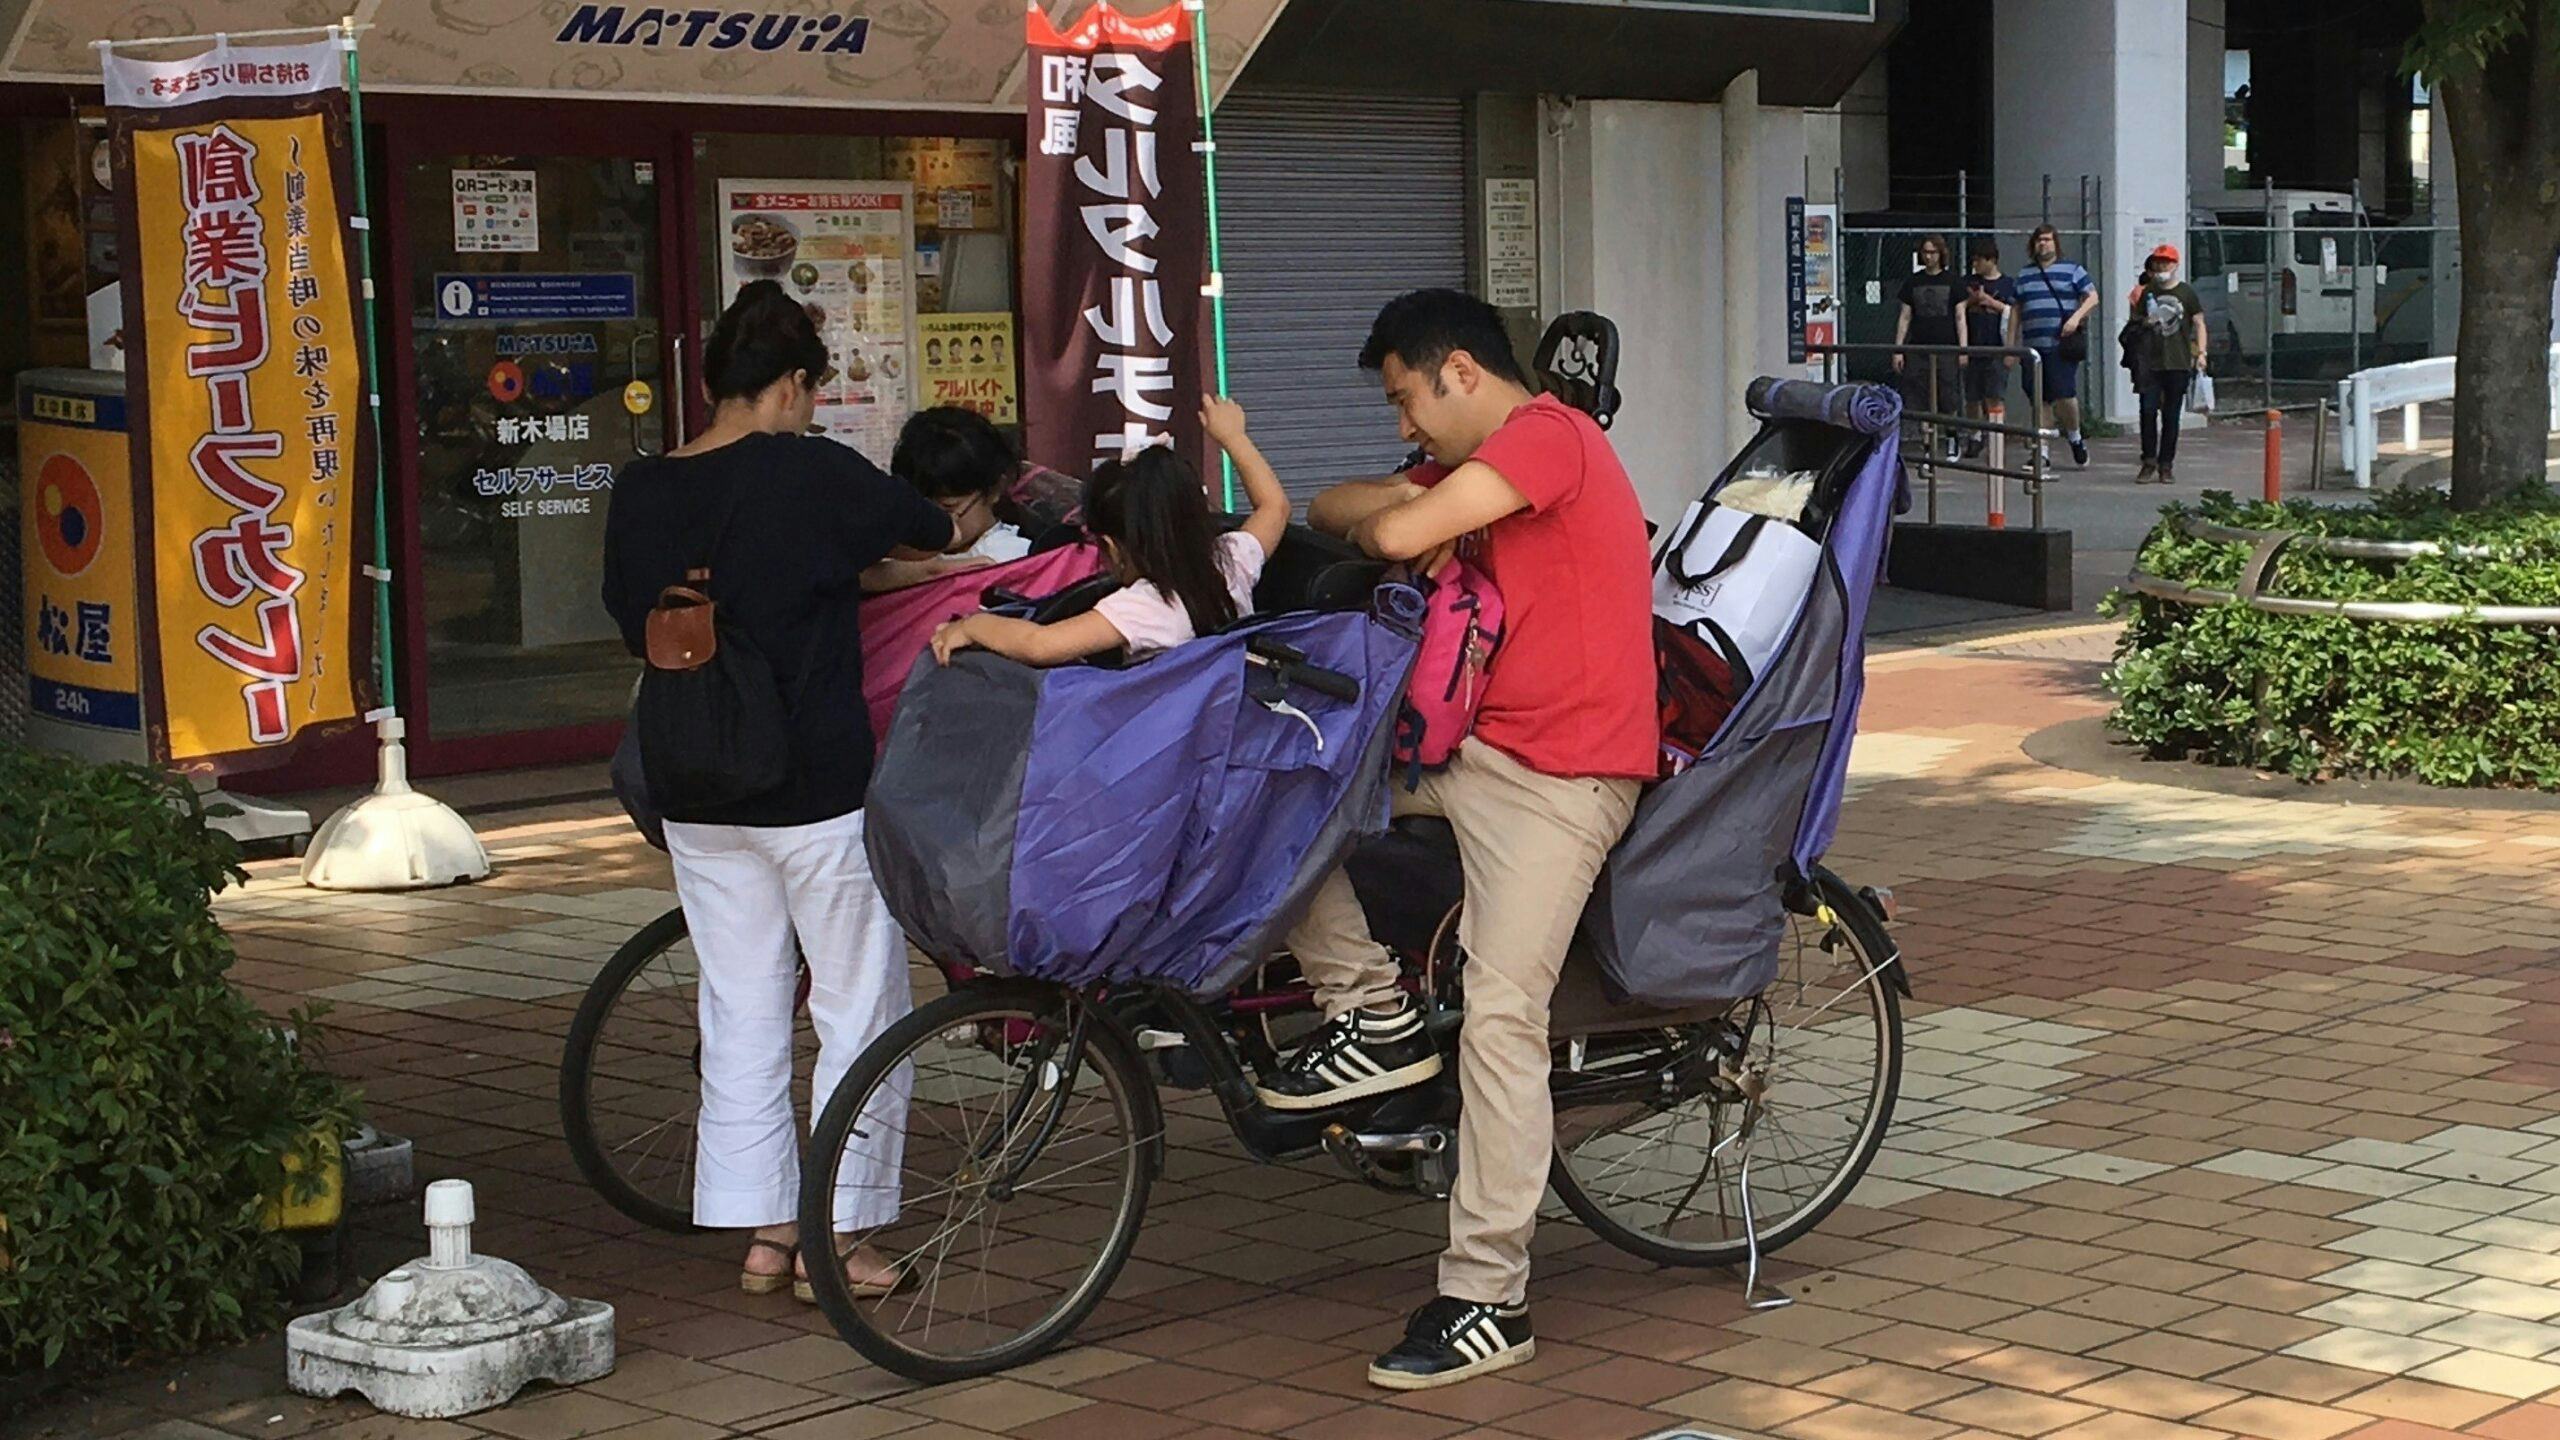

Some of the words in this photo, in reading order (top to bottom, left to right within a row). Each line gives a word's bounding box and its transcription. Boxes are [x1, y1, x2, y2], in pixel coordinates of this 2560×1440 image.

[556, 5, 870, 54] MATSUYA
[455, 178, 533, 193] QRコード決済
[1793, 310, 1801, 329] 5
[498, 331, 599, 355] MATSUYA
[933, 378, 1003, 399] アルバイト
[496, 414, 590, 445] 新木場店
[473, 463, 615, 496] セルフサービス
[501, 500, 534, 518] SELF
[537, 498, 591, 516] SERVICE
[37, 593, 113, 665] 松屋
[54, 688, 91, 716] 24h
